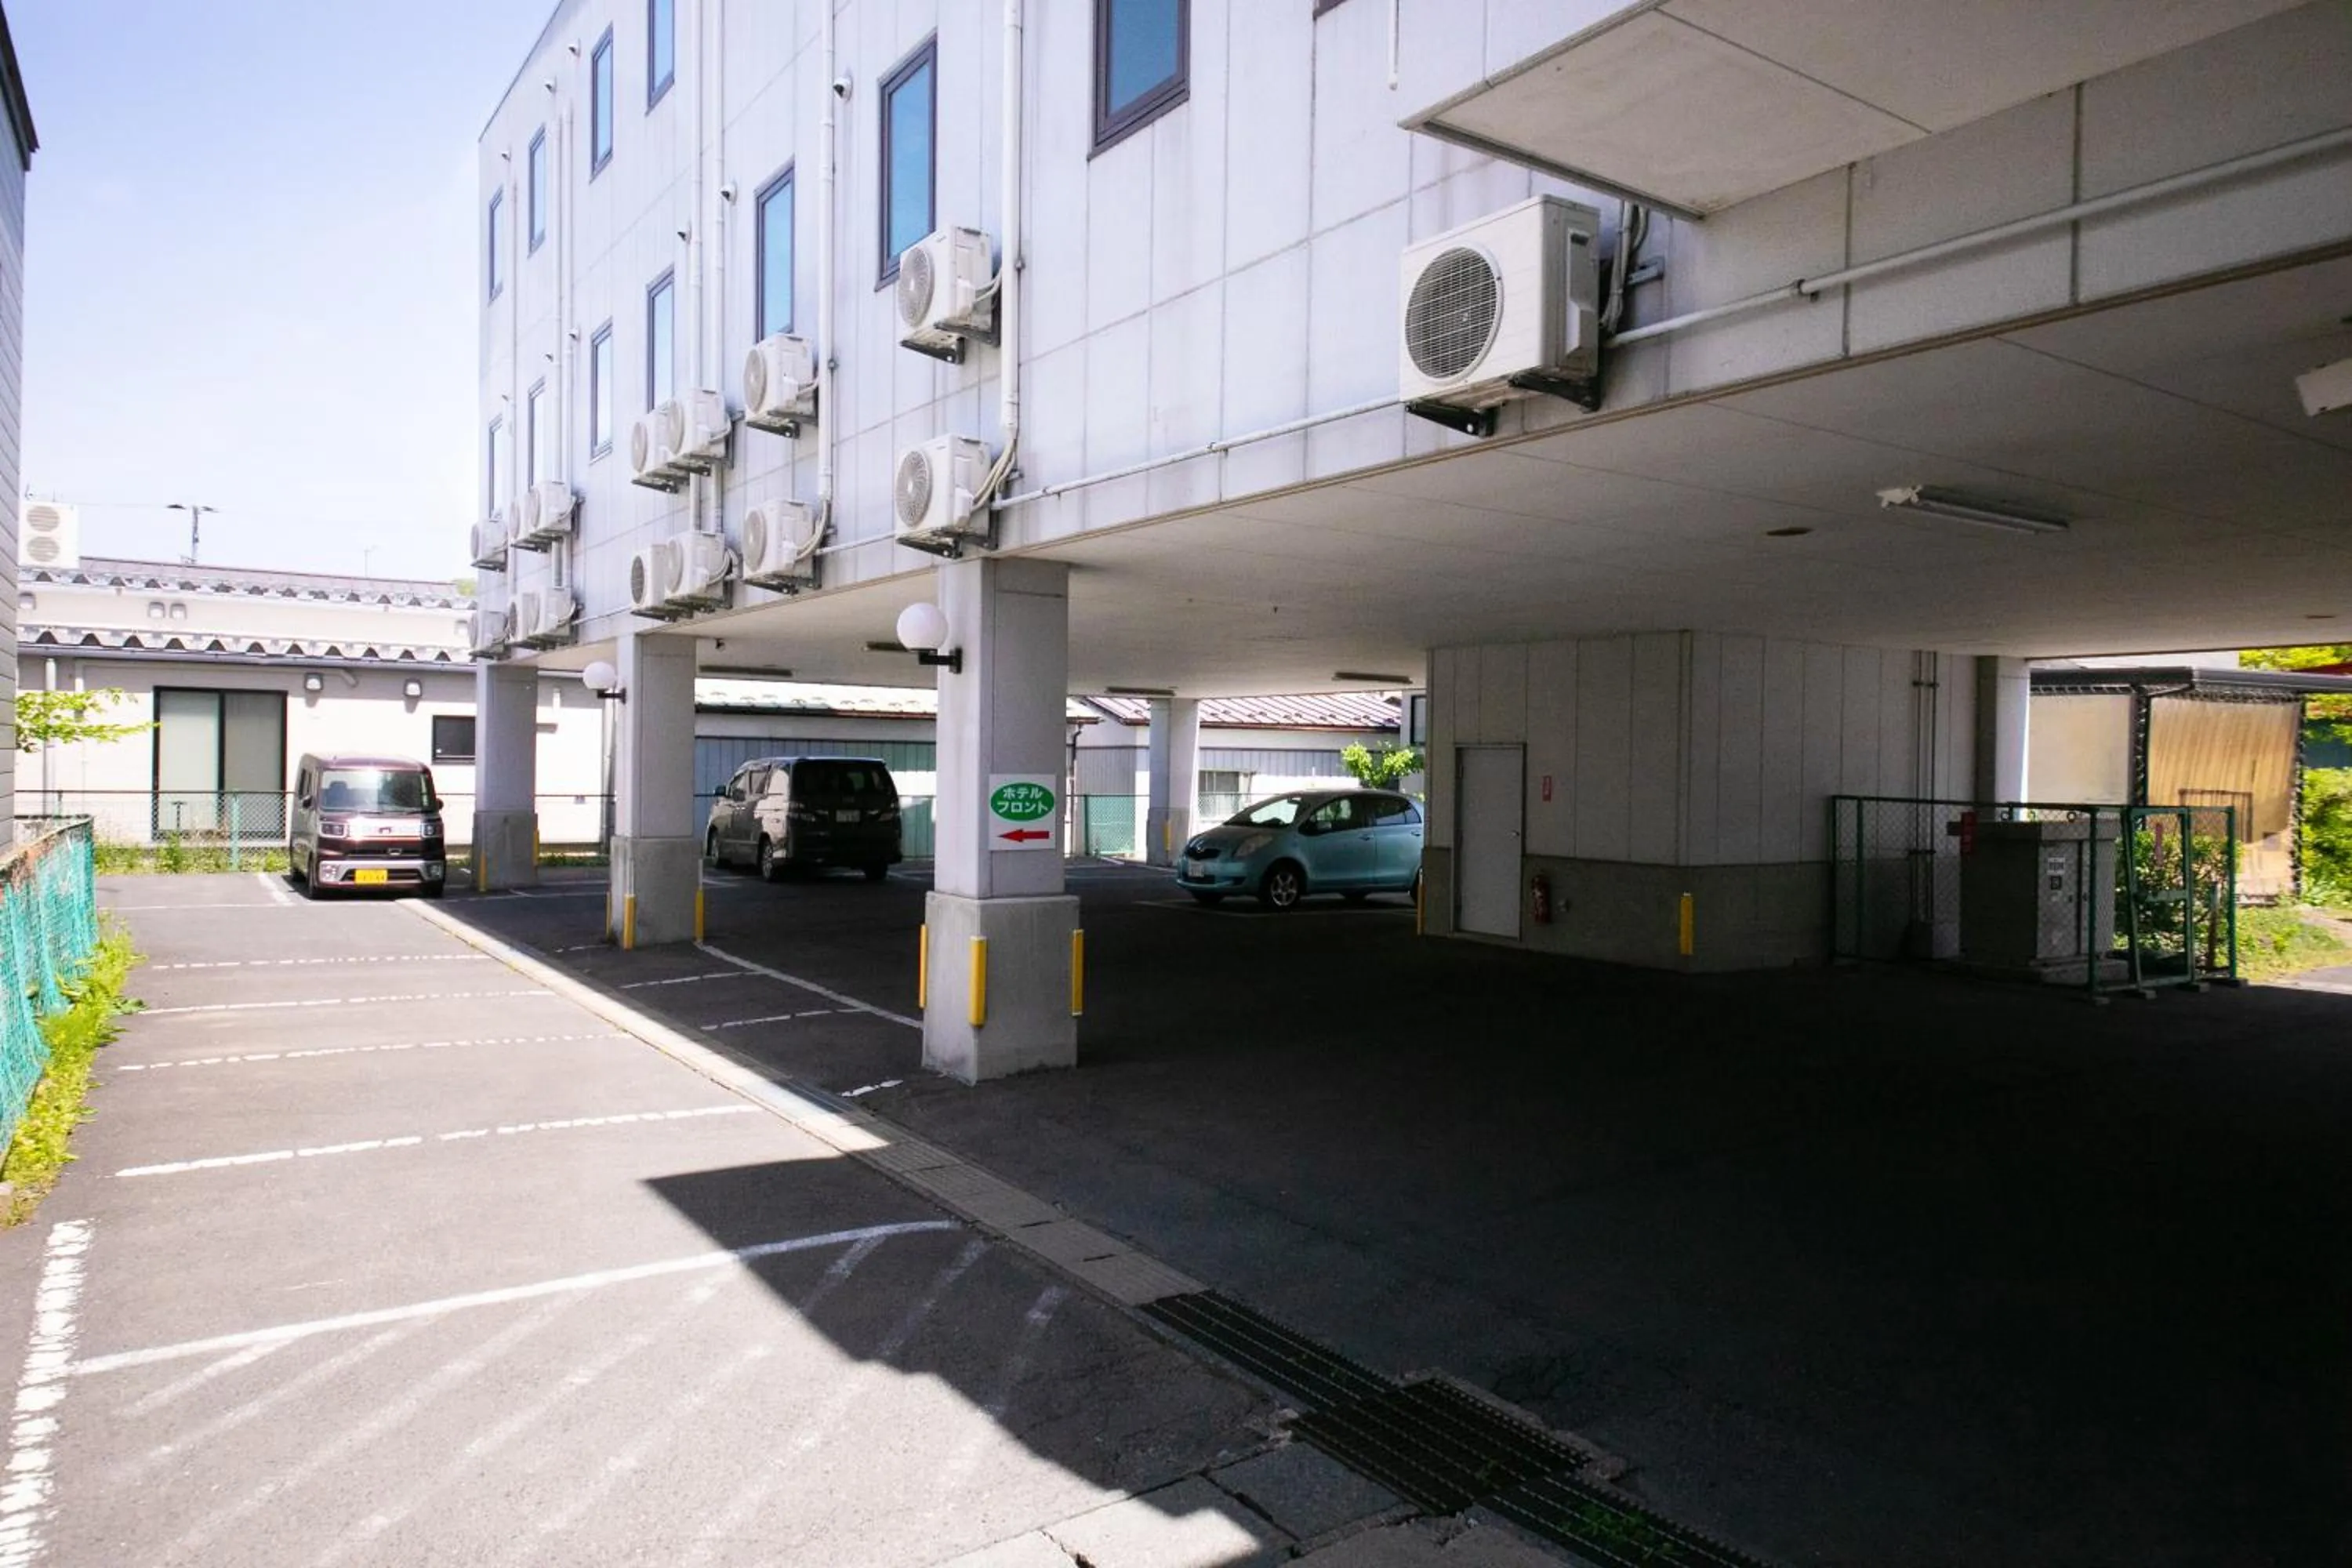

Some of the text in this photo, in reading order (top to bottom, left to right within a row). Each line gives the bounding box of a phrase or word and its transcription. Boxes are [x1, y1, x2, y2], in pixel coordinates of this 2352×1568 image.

[1003, 787, 1044, 799] ホテル
[996, 800, 1048, 814] フロント
